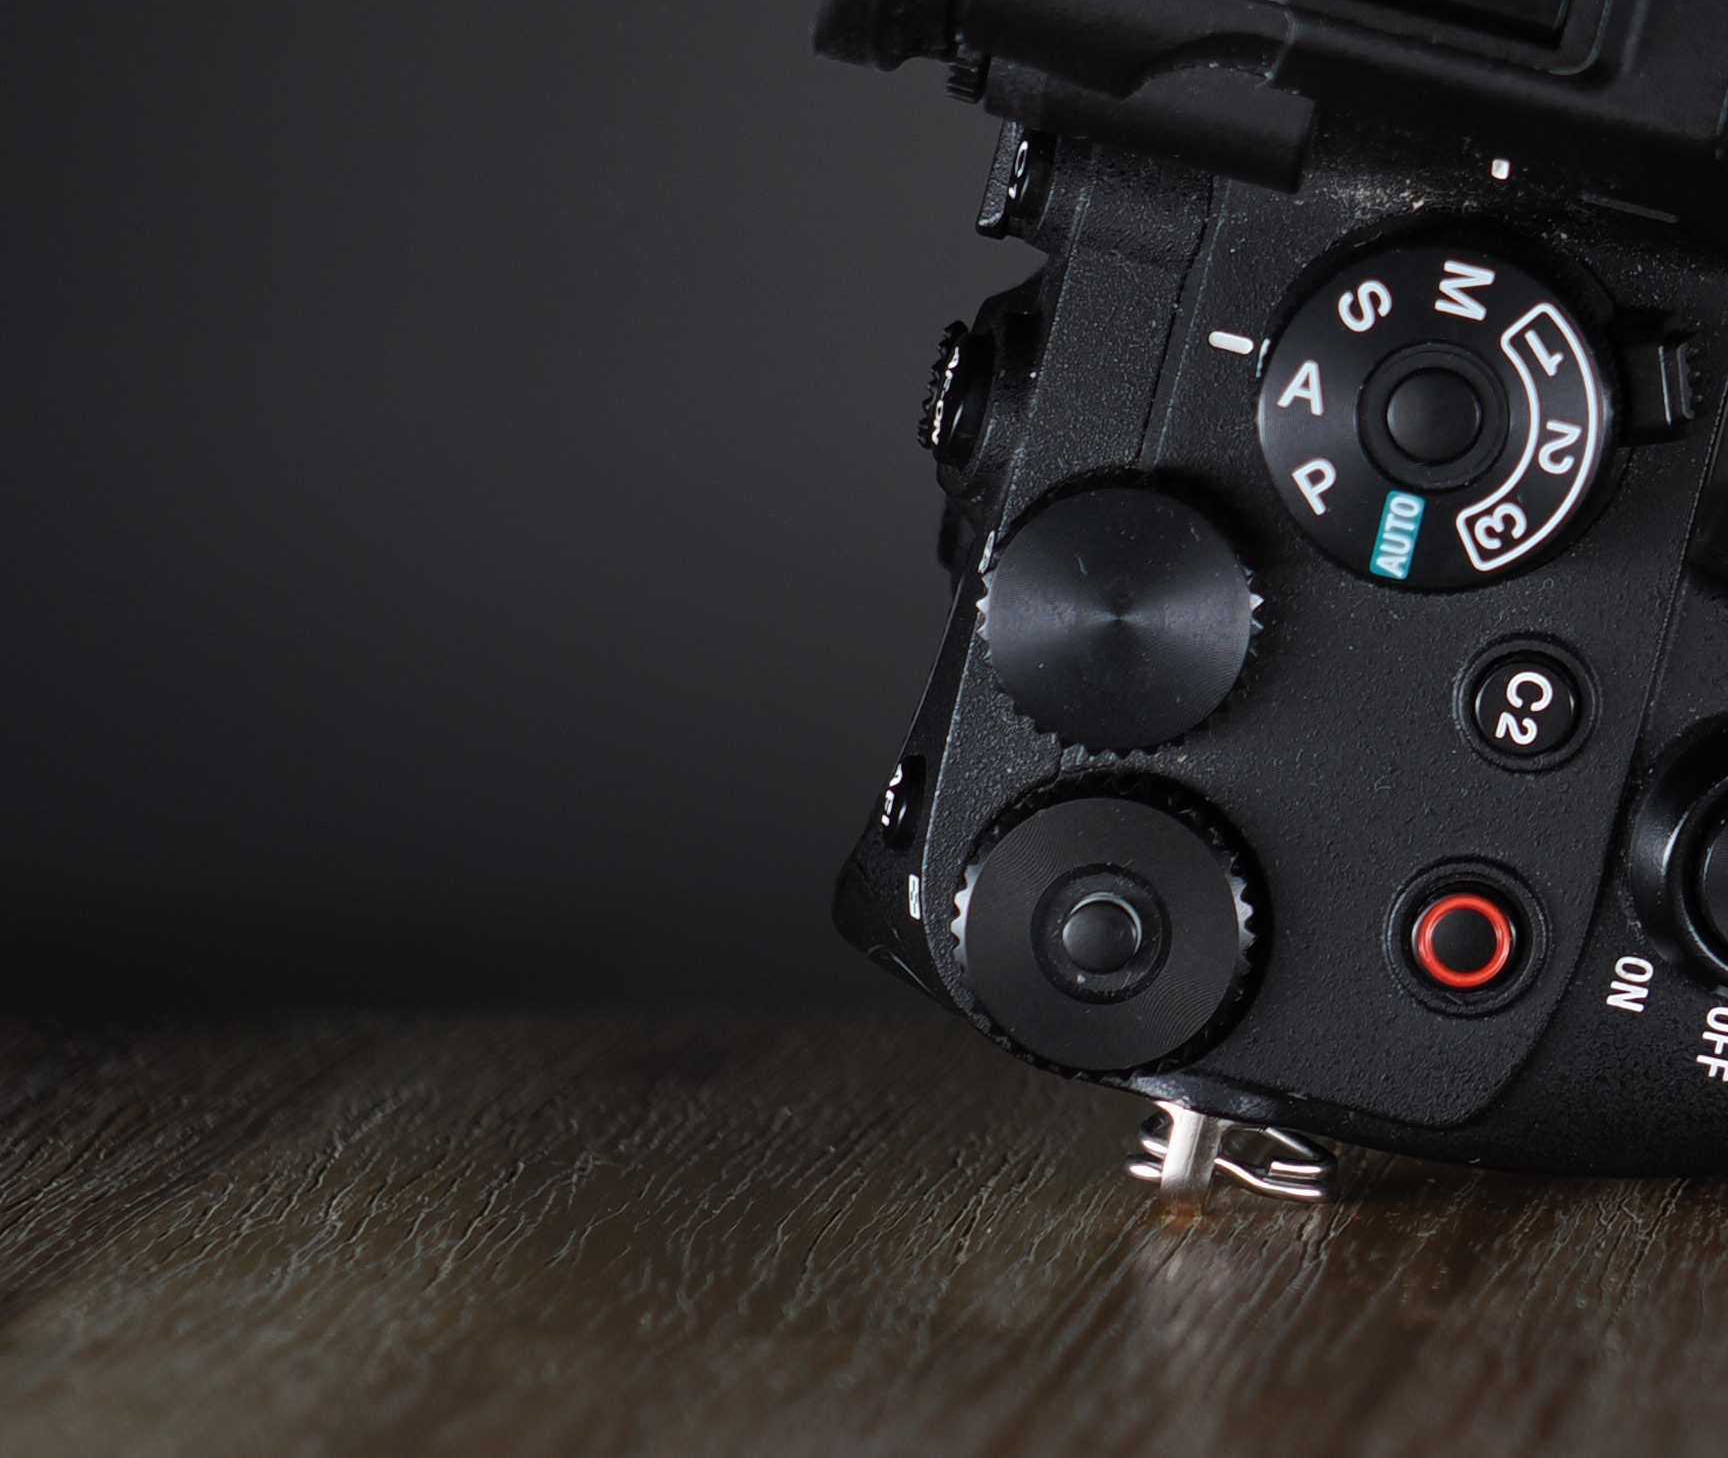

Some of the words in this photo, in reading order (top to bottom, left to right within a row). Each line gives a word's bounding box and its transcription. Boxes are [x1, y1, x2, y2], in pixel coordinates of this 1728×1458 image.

[1337, 280, 1392, 333] S
[1434, 260, 1496, 321] M
[1524, 330, 1565, 377] 1
[1276, 360, 1324, 416] A
[1537, 420, 1582, 475] 2
[1291, 458, 1337, 516] P
[1376, 492, 1424, 578] AUTO
[1473, 501, 1528, 551] 3
[1495, 671, 1554, 745] C2
[1606, 956, 1654, 1013] ON
